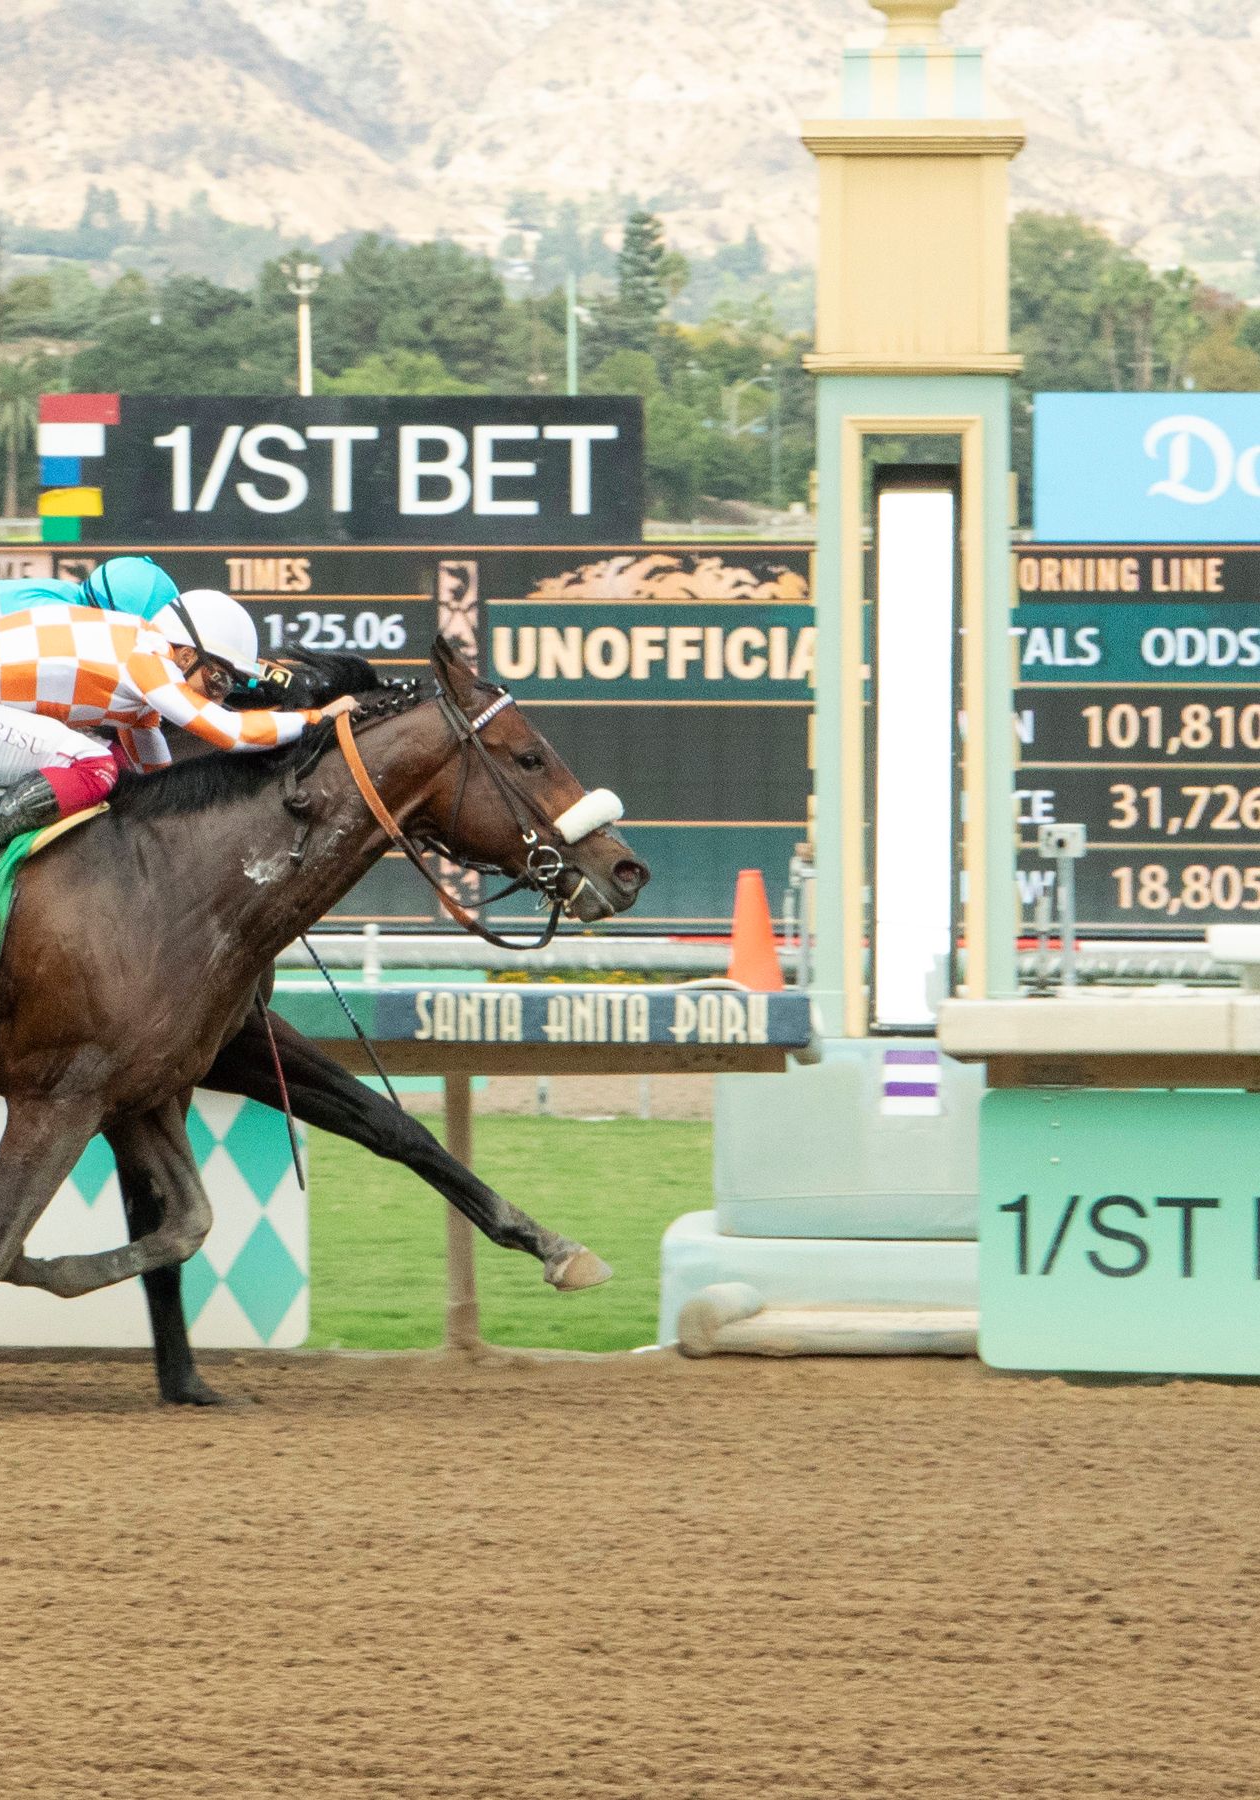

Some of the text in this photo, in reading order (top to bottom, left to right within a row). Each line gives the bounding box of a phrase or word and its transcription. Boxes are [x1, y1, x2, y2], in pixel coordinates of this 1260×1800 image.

[153, 424, 618, 515] 1/ST BET
[225, 558, 312, 592] TIMES
[1019, 557, 1225, 593] ORNING LINE
[492, 626, 870, 680] UNOFFICIA
[1141, 627, 1260, 667] ODDS
[1082, 703, 1260, 755] 101,810
[1109, 784, 1260, 835] 31,726
[1112, 864, 1260, 916] 18,805
[414, 990, 769, 1044] SANTA ANITA PARK
[997, 1194, 1221, 1278] 1/ST
